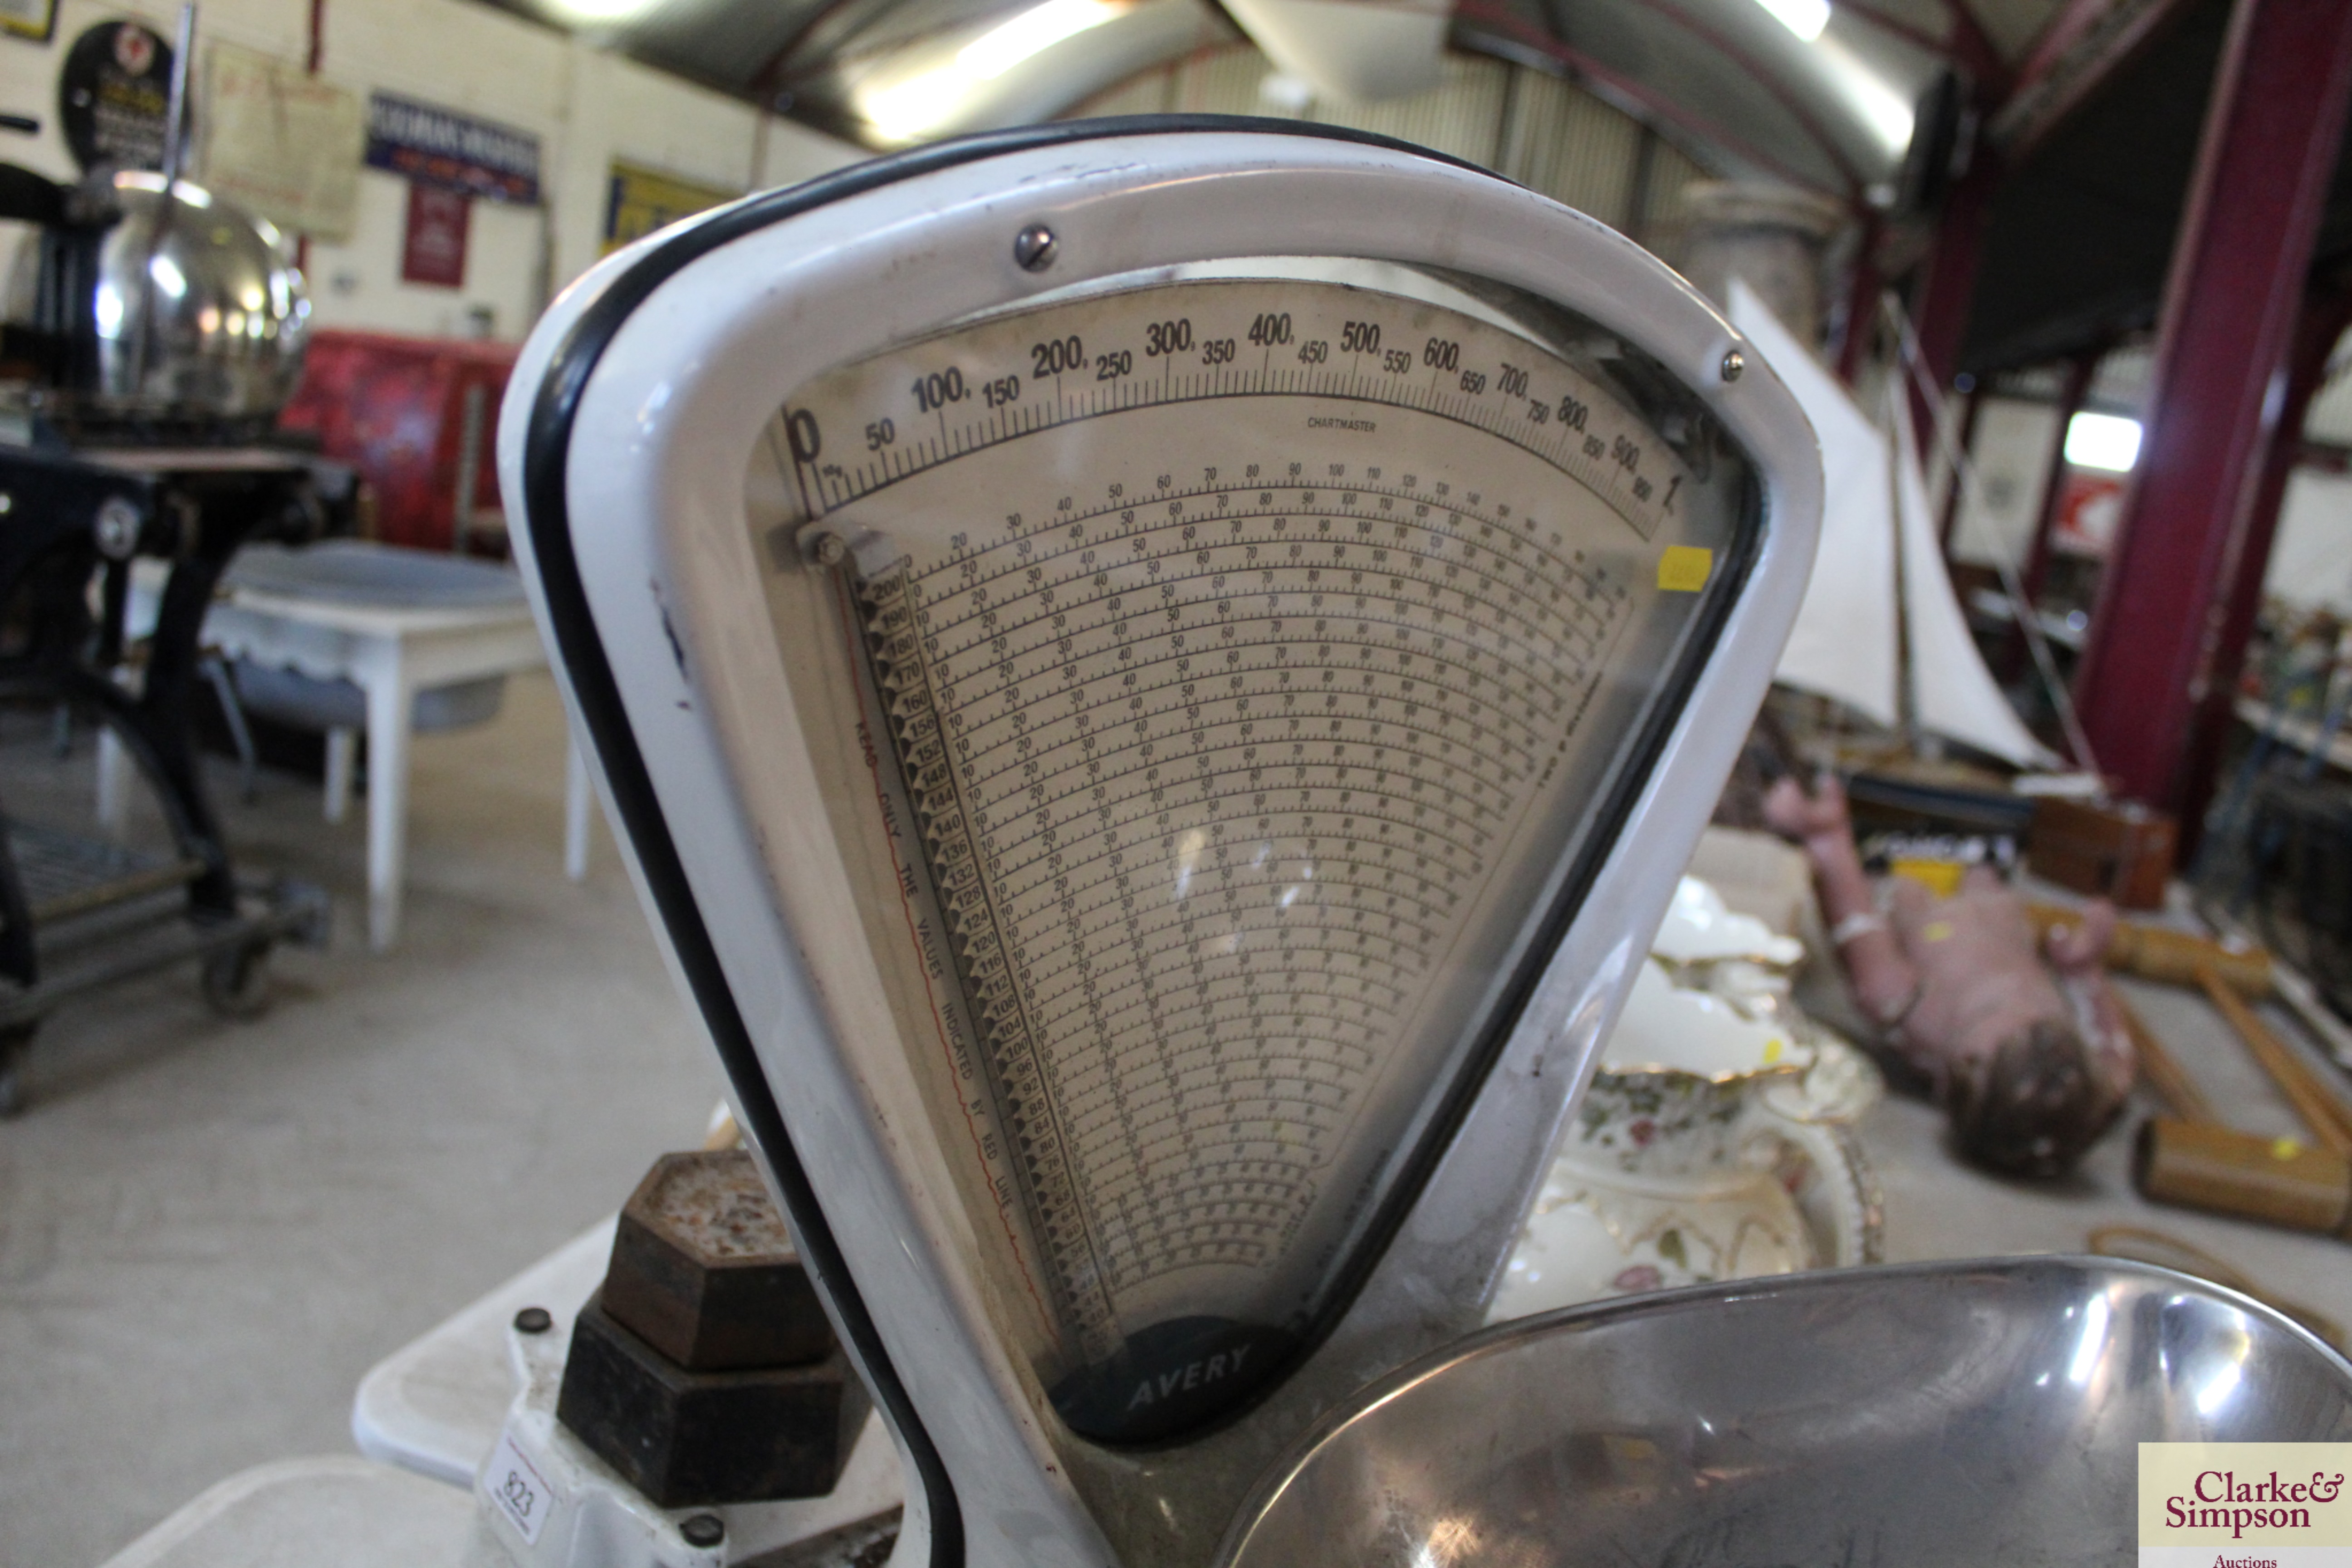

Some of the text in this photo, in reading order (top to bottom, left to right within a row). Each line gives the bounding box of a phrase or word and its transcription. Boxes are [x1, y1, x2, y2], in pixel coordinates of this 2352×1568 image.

[865, 417, 895, 451] 50
[983, 375, 1019, 408] 150
[1096, 350, 1132, 381] 250
[1202, 338, 1235, 365] 350
[1298, 340, 1328, 363] 450
[1383, 349, 1411, 374] 550
[1460, 370, 1486, 395] 650
[1527, 399, 1549, 424] 750
[1583, 434, 1605, 460] 850
[1308, 417, 1376, 432] CHARTMASTER
[951, 532, 967, 549] 20
[1007, 513, 1021, 529] 30
[1057, 497, 1072, 512] 40
[1109, 484, 1122, 498] 50
[1157, 475, 1171, 489] 60
[1205, 467, 1216, 480] 70
[1246, 464, 1259, 477] 80
[1289, 463, 1301, 475] 90
[1329, 464, 1344, 476] 100
[1367, 467, 1381, 479] 110
[1402, 474, 1416, 487] 120
[960, 492, 1429, 578] 20 30 40 50 60 70 80 90 100 110 120
[916, 519, 1407, 626] 10 20 30 40 50 60 70 80 90 100 110
[873, 575, 899, 600] 200
[924, 545, 1387, 653] 10 20 30 40 50 60 70 80 90 100
[882, 607, 906, 629] 190
[936, 570, 1319, 679] 10 20 30 40 50 60 70 80
[889, 634, 913, 658] 180
[941, 608, 1179, 704] 10 20 30 40 50
[895, 662, 919, 685] 170
[949, 635, 1184, 729] 10 20 30 40 50
[903, 690, 927, 713] 160
[956, 659, 1189, 754] 10 20 30 40 50
[910, 714, 935, 737] 156
[961, 684, 1194, 779] 10 20 30 40 50
[916, 740, 941, 762] 152
[968, 707, 1199, 803] 10 20 30 40 50
[922, 764, 947, 787] 148
[928, 789, 953, 810] 144
[935, 814, 960, 836] 140
[942, 839, 967, 862] 136
[949, 864, 974, 886] 132
[956, 886, 980, 908] 128
[1007, 926, 1019, 940] 10
[1061, 899, 1074, 912] 20
[1116, 876, 1129, 889] 30
[1216, 847, 1227, 859] 50
[964, 909, 988, 931] 124
[971, 931, 995, 953] 120
[855, 720, 1012, 1210] READ ONLY THE VALUES INDICATED BY RED LINE
[979, 952, 1002, 974] 116
[986, 975, 1009, 996] 112
[992, 994, 1015, 1016] 108
[1031, 981, 1095, 1022] 10 20
[999, 1017, 1021, 1038] 104
[1005, 1038, 1028, 1058] 100
[1048, 1040, 1112, 1079] 10 20
[1017, 1058, 1032, 1077] 96
[1023, 1077, 1037, 1095] 92
[1029, 1097, 1045, 1115] 88
[1034, 1117, 1049, 1135] 84
[1040, 1137, 1055, 1153] 80
[1127, 1343, 1251, 1411] AVERY
[504, 1471, 534, 1516] 823
